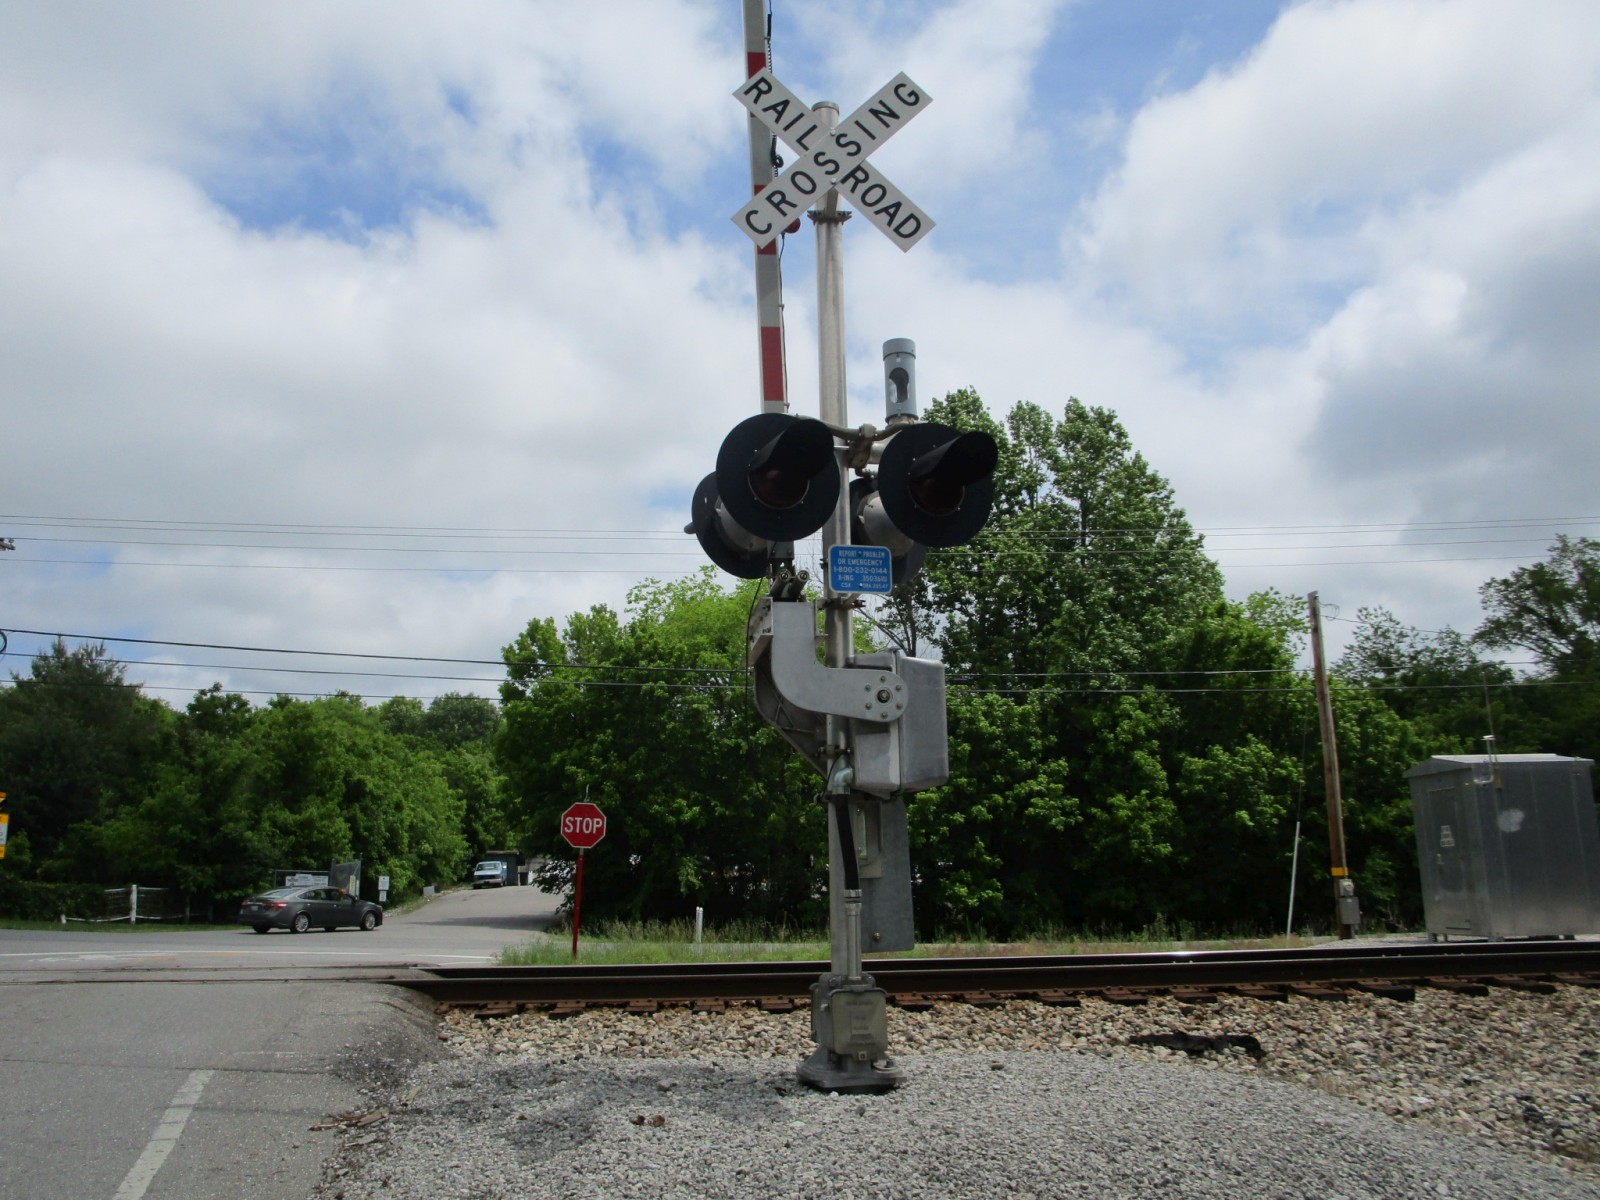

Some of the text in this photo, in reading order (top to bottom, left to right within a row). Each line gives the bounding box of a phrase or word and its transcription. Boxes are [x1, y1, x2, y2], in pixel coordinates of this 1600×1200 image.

[743, 76, 921, 239] RAIL ROAD
[745, 83, 920, 235] CROSSING
[564, 816, 603, 834] STOP
